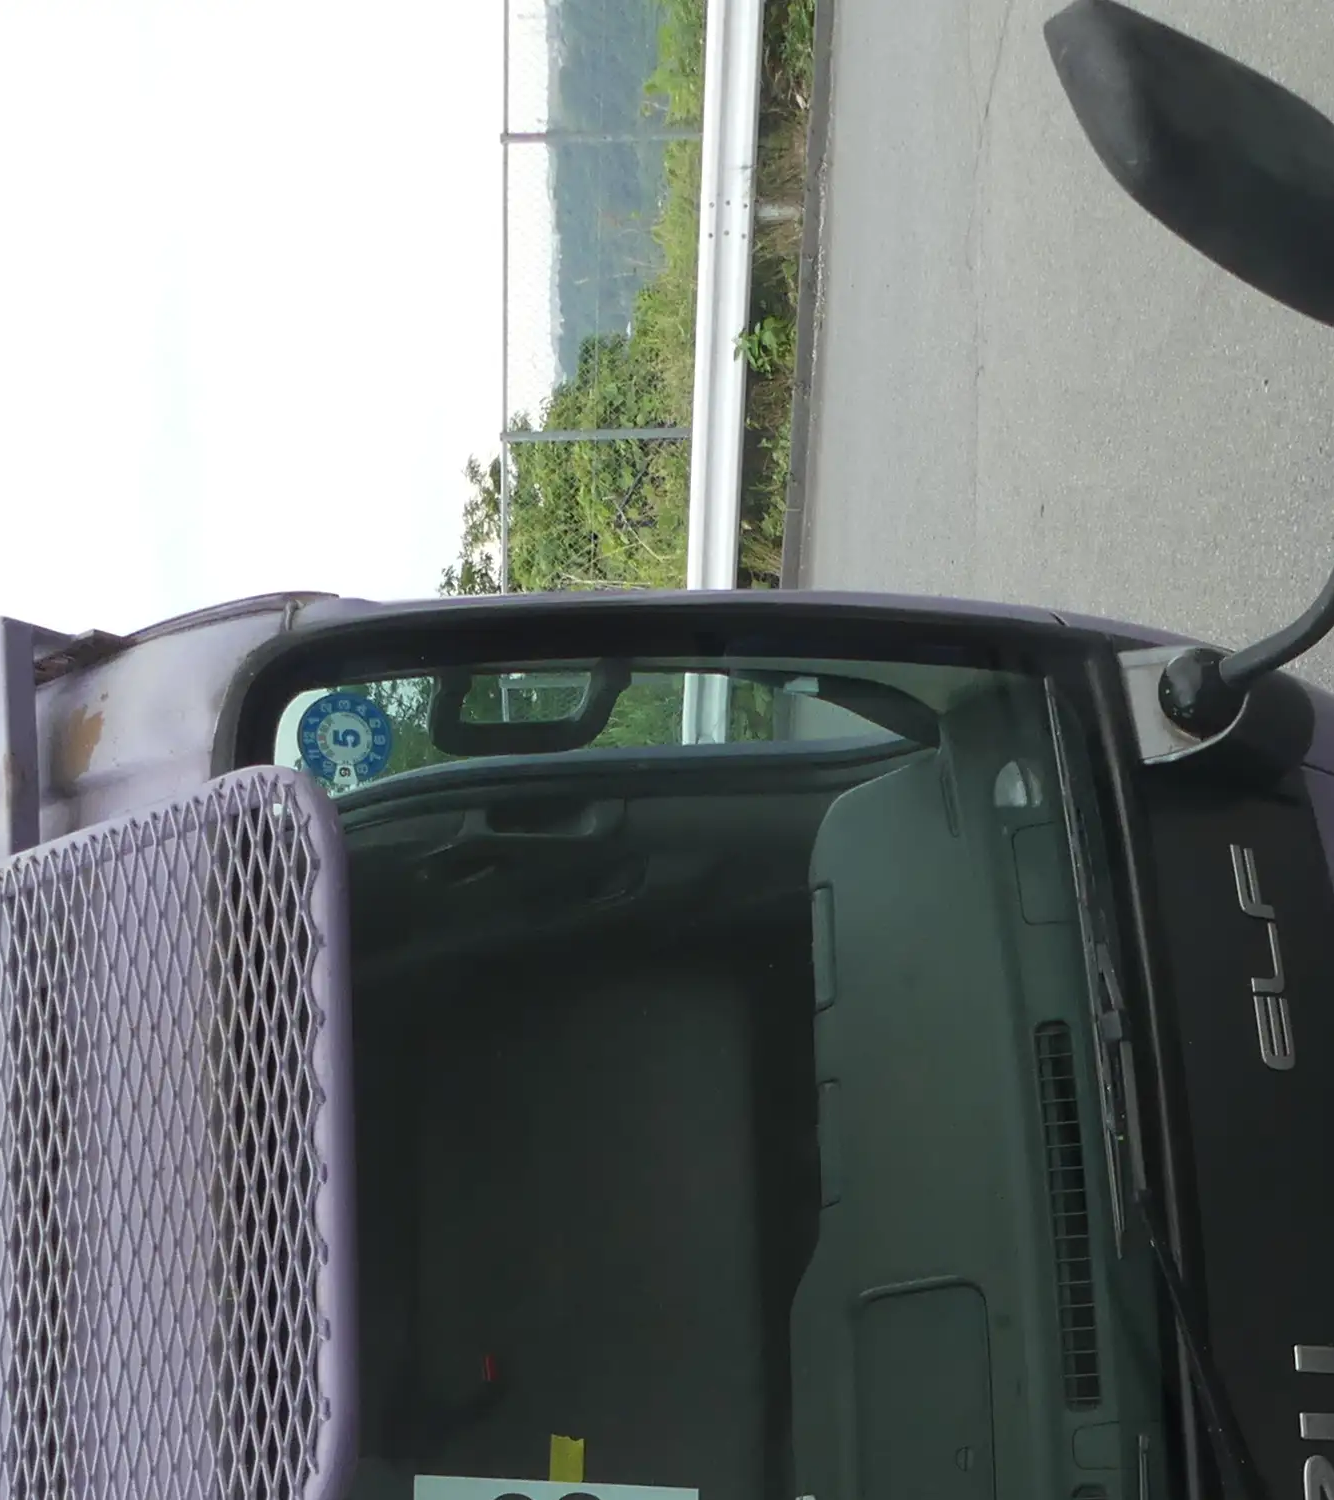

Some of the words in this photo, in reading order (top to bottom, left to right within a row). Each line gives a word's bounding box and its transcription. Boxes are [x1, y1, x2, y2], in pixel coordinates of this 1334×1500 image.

[332, 728, 361, 749] 5
[339, 765, 352, 778] 9
[1229, 843, 1296, 1070] ELF
